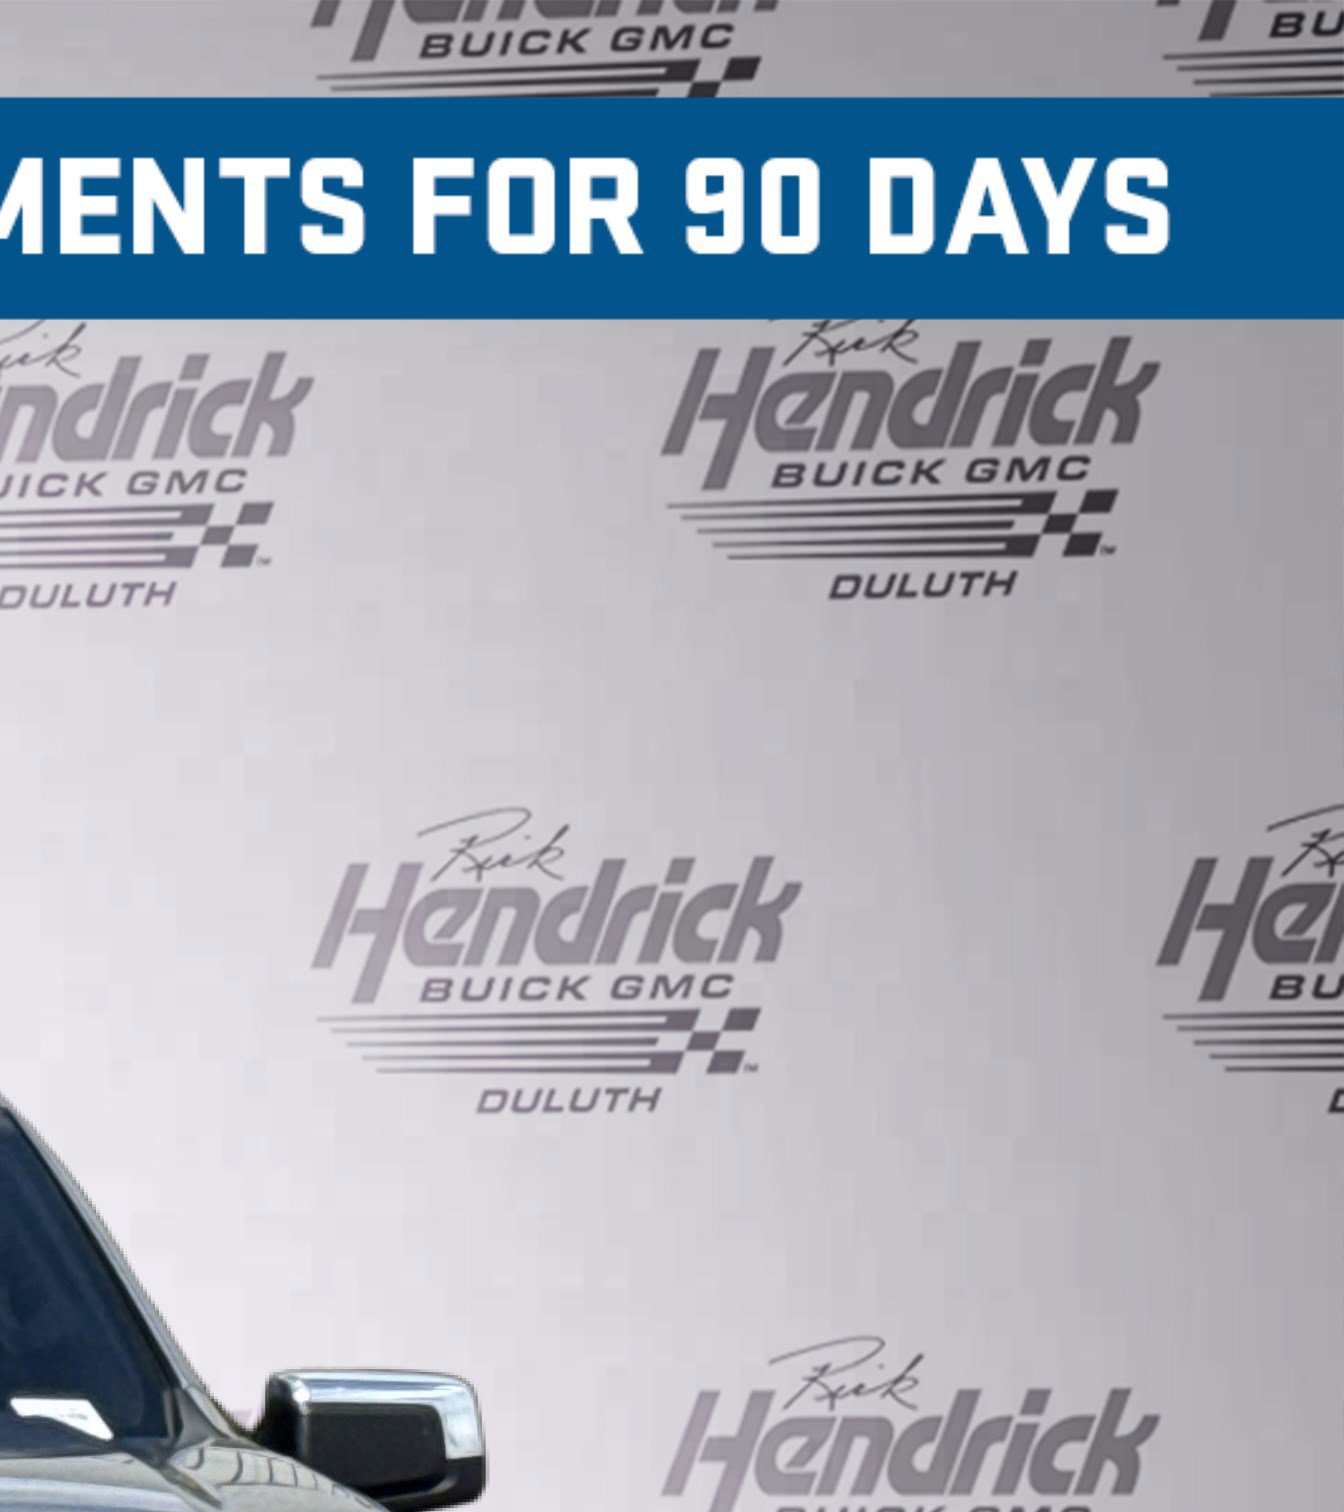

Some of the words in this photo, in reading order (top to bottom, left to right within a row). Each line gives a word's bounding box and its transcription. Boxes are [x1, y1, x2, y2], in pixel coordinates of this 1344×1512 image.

[418, 28, 593, 60] BUICK
[608, 23, 735, 53] GMC
[660, 336, 1161, 491] Hendrick
[126, 468, 248, 496] GMC
[771, 458, 947, 488] BUICK
[964, 455, 1092, 483] GMC
[828, 570, 1018, 600] DULUTH
[311, 855, 803, 1003] Hendrick
[418, 975, 592, 1002] BUICK
[609, 973, 735, 1000] GMC
[475, 1086, 663, 1115] DULUTH
